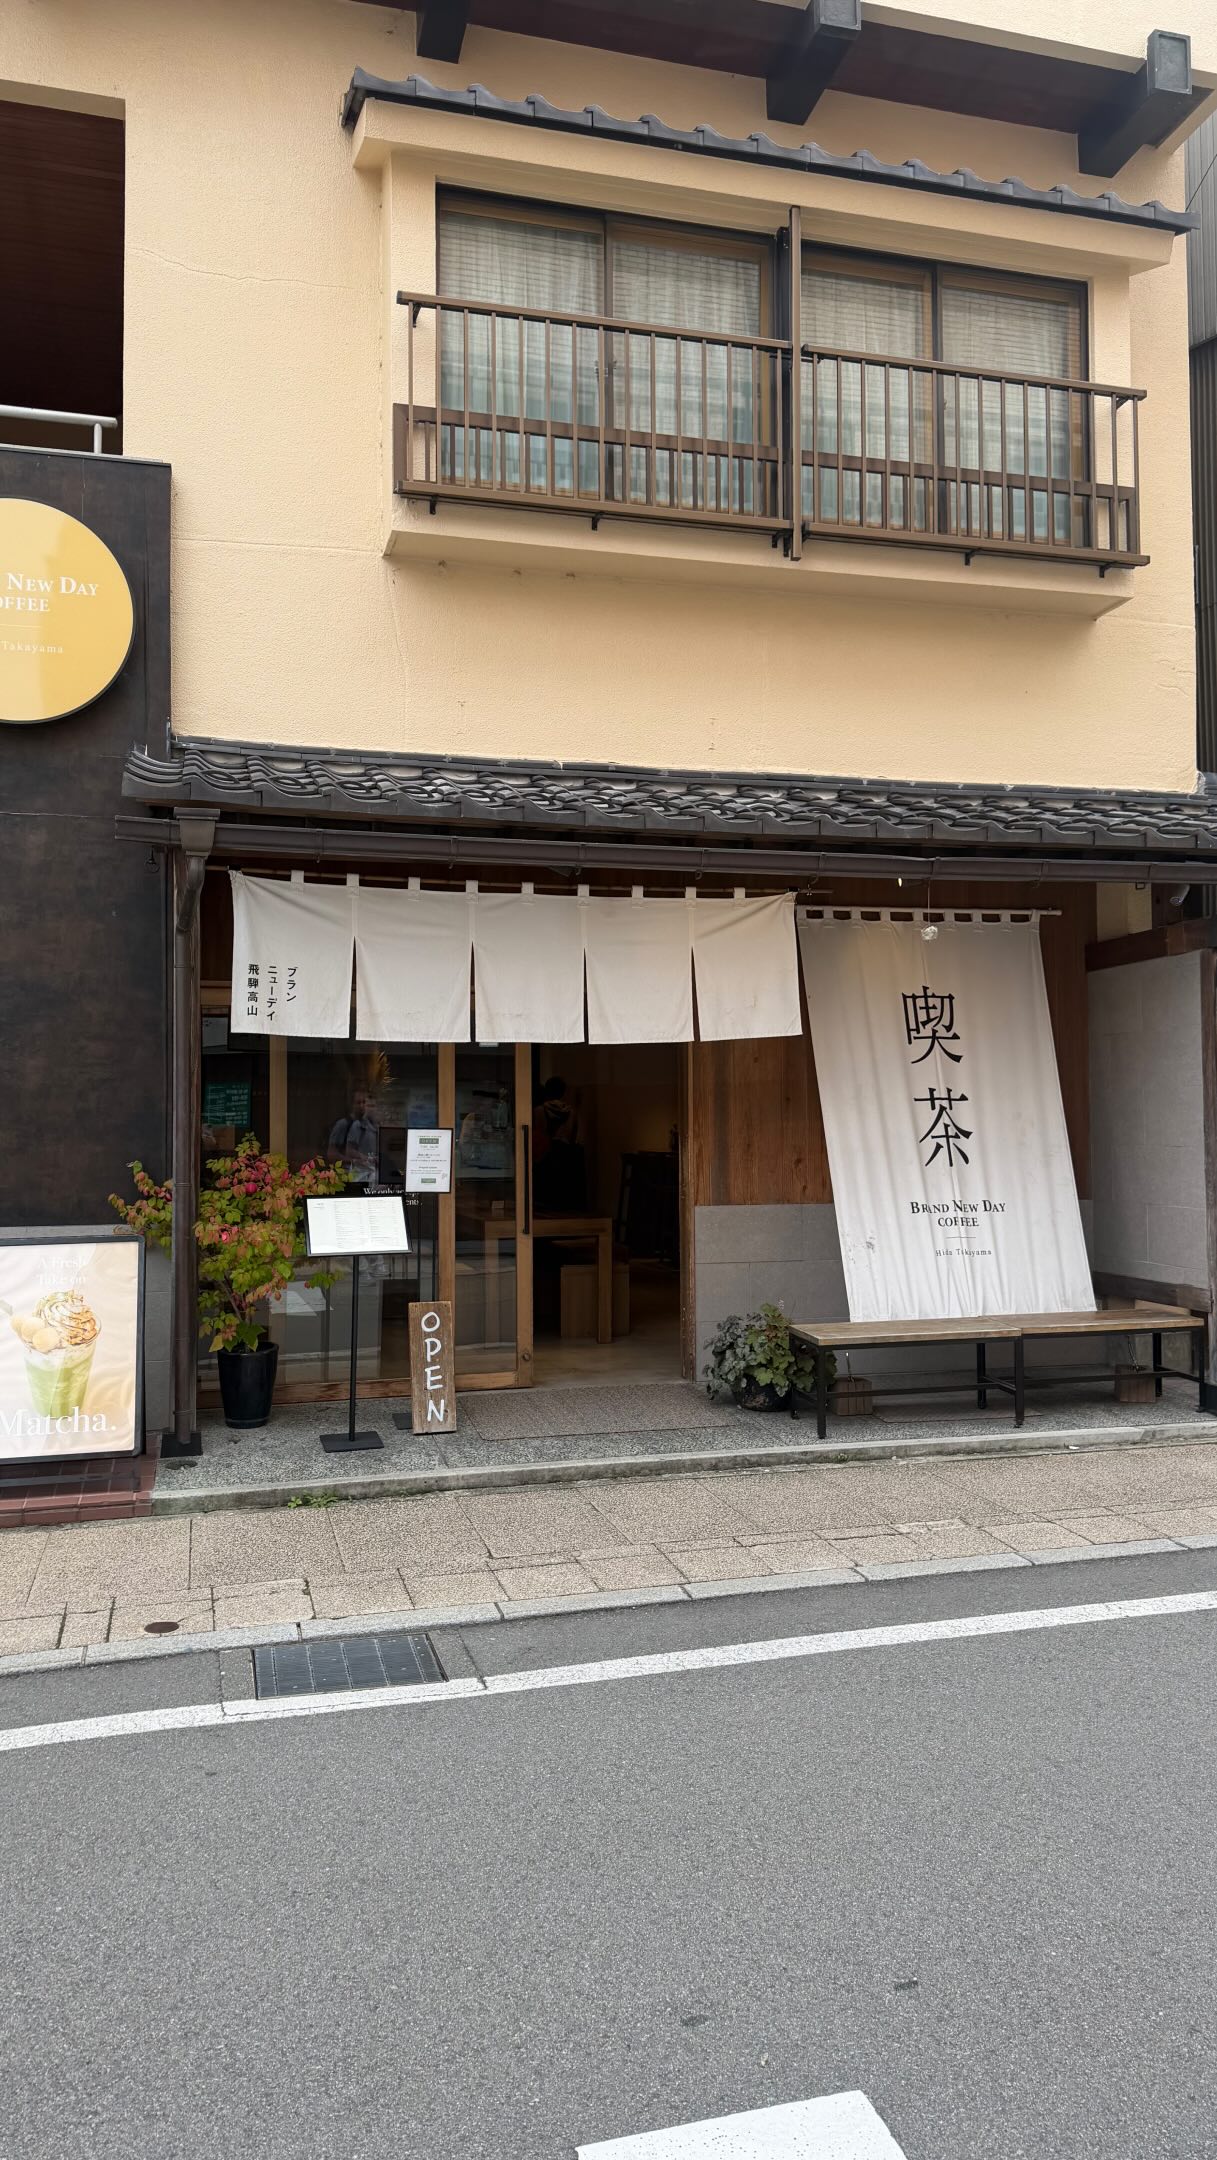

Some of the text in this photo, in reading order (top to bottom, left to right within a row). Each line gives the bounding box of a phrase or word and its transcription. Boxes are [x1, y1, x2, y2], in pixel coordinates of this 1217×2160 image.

[2, 640, 64, 654] Takayama
[247, 964, 260, 1017] 飛騨高山
[286, 966, 298, 1002] ブラン
[902, 985, 973, 1168] 喫茶
[938, 1216, 980, 1227] COFFEE
[935, 1249, 953, 1257] Hida
[421, 1311, 444, 1422] OPEN
[0, 1405, 117, 1437] Matcha.
